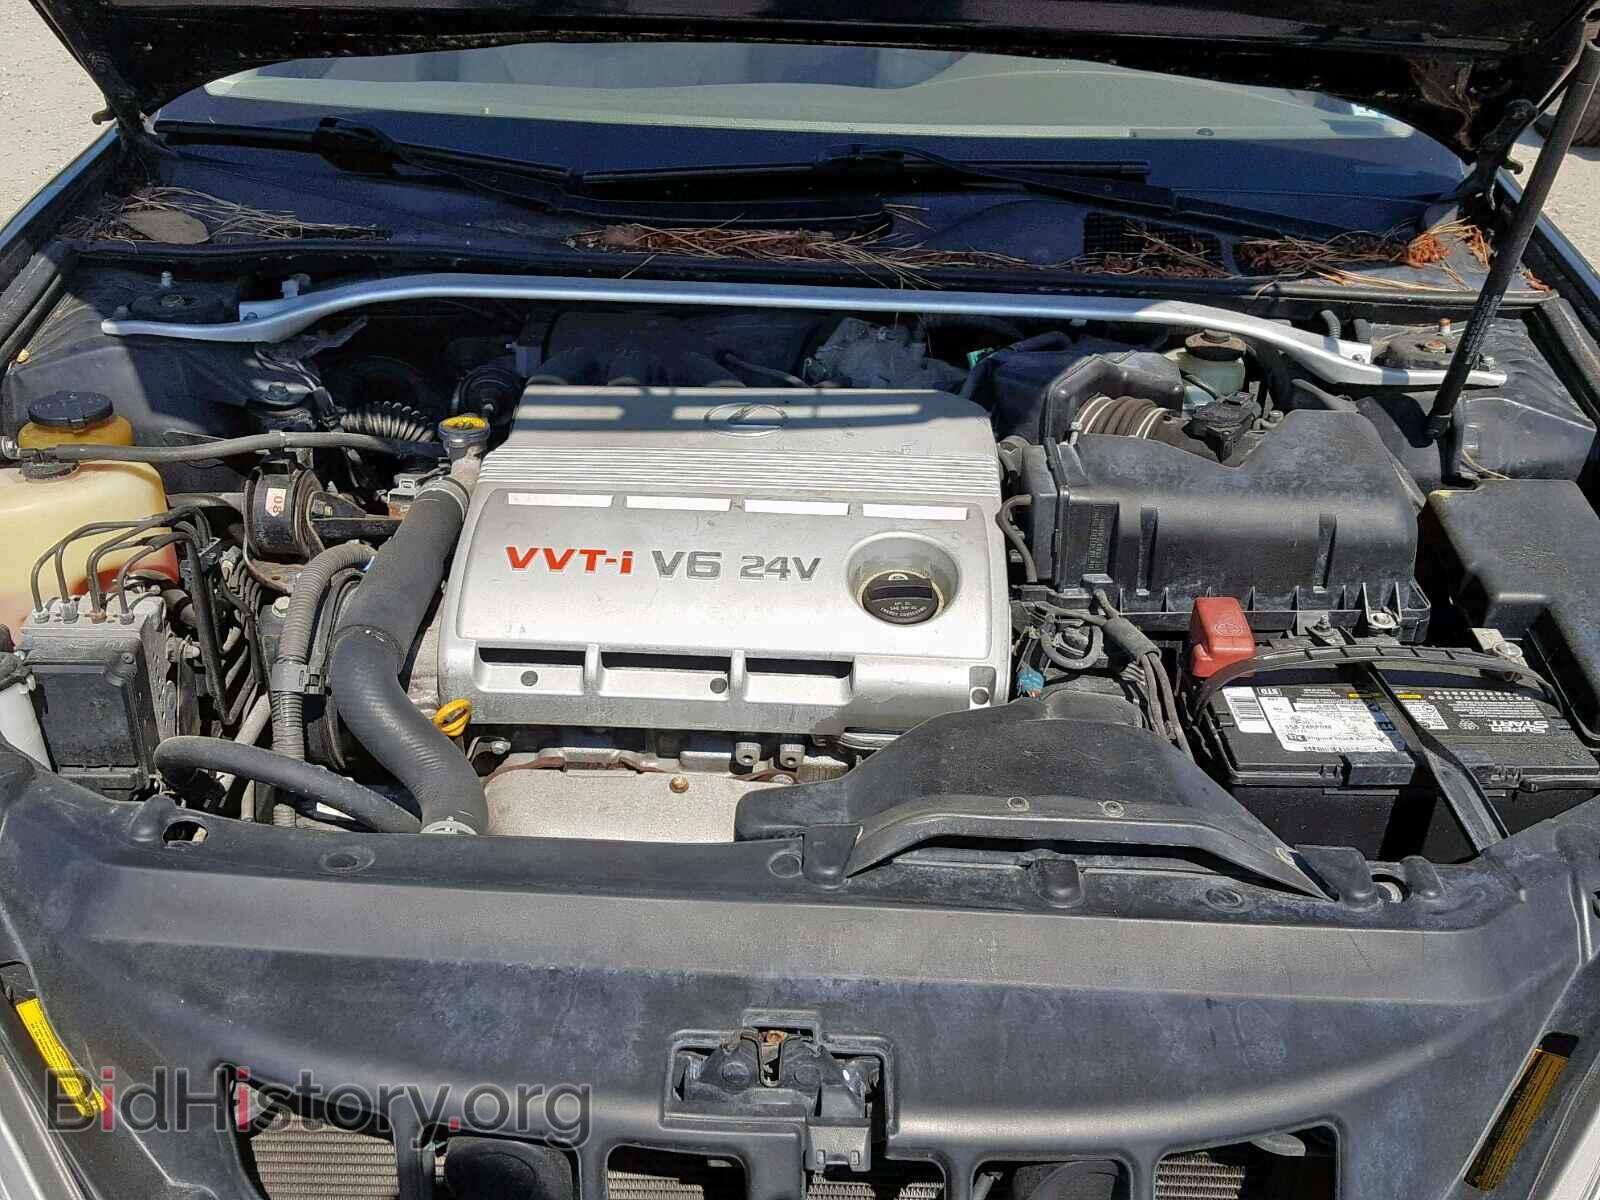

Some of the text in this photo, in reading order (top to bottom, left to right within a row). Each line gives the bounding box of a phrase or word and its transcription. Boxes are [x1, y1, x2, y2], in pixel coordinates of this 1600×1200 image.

[505, 546, 822, 581] VVT-i V6 24V
[1487, 719, 1549, 730] START
[1490, 723, 1546, 734] SUPER
